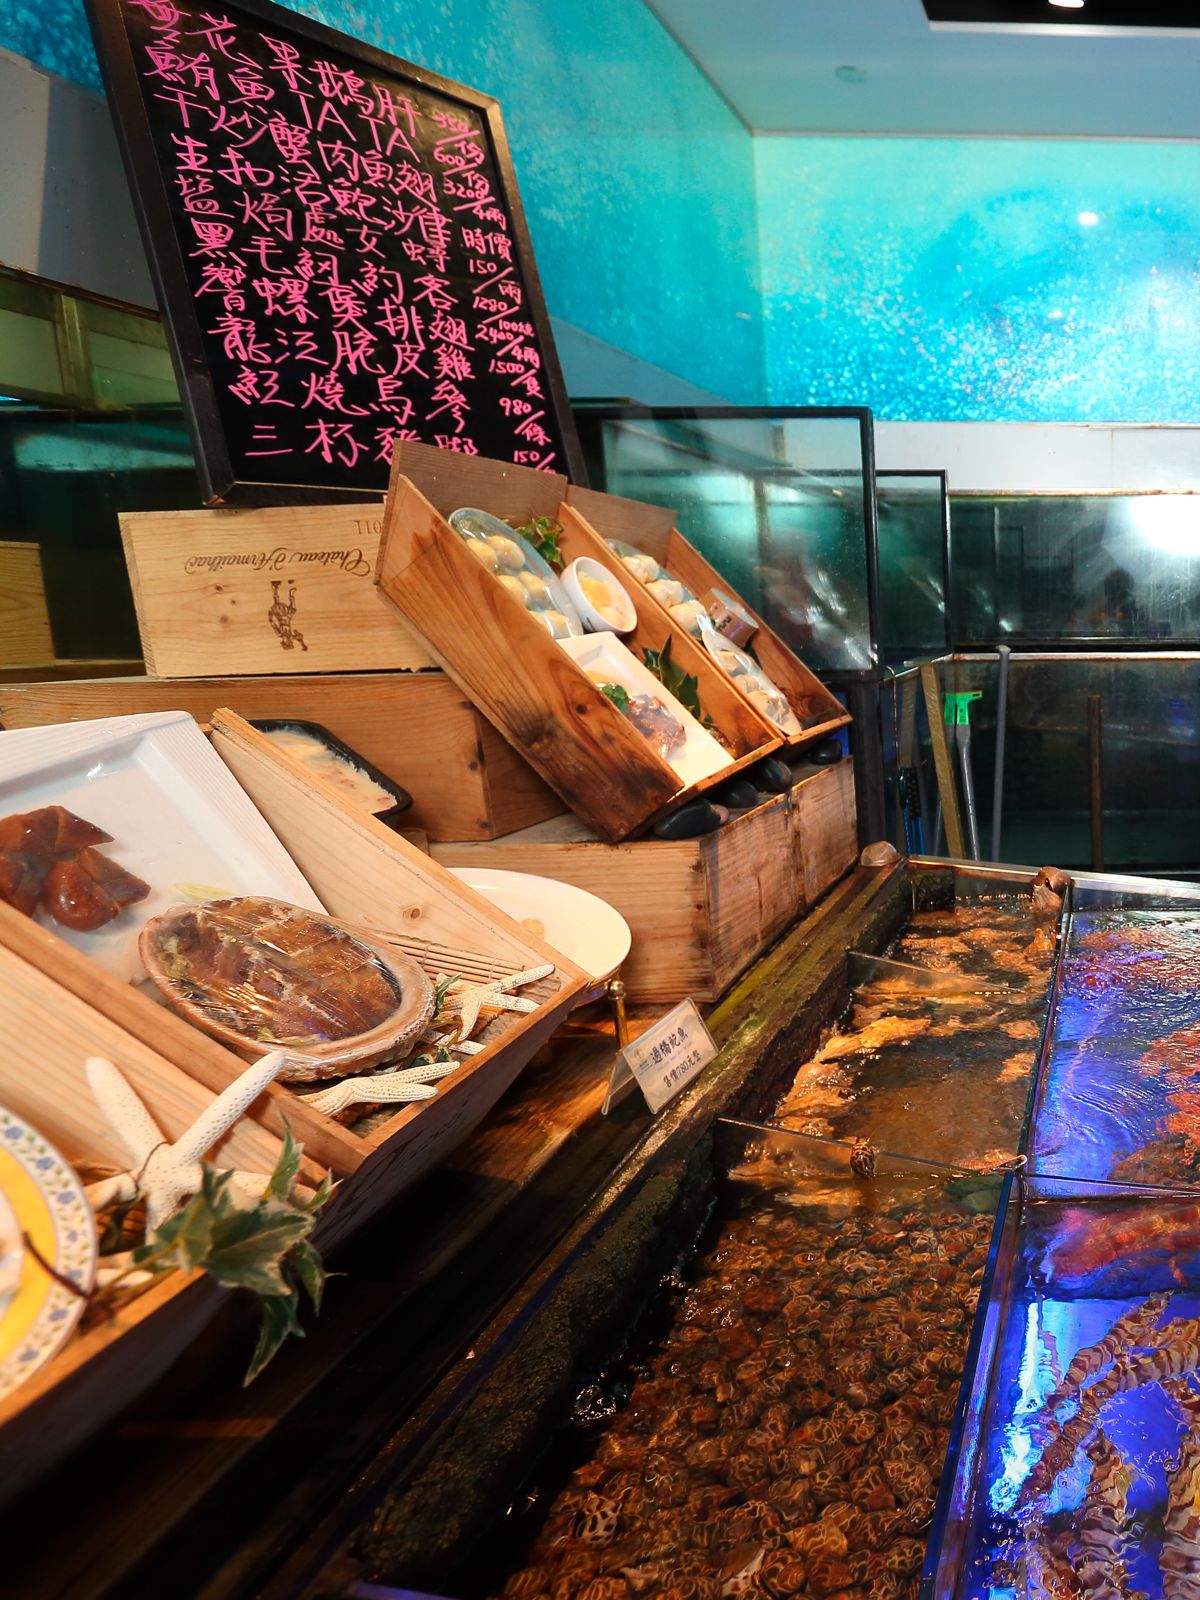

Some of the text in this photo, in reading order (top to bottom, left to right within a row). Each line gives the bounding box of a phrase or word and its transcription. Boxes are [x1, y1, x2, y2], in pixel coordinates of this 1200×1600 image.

[460, 226, 512, 262] 時價
[514, 449, 556, 473] 150/
[184, 547, 371, 577] Château d'Armailhac
